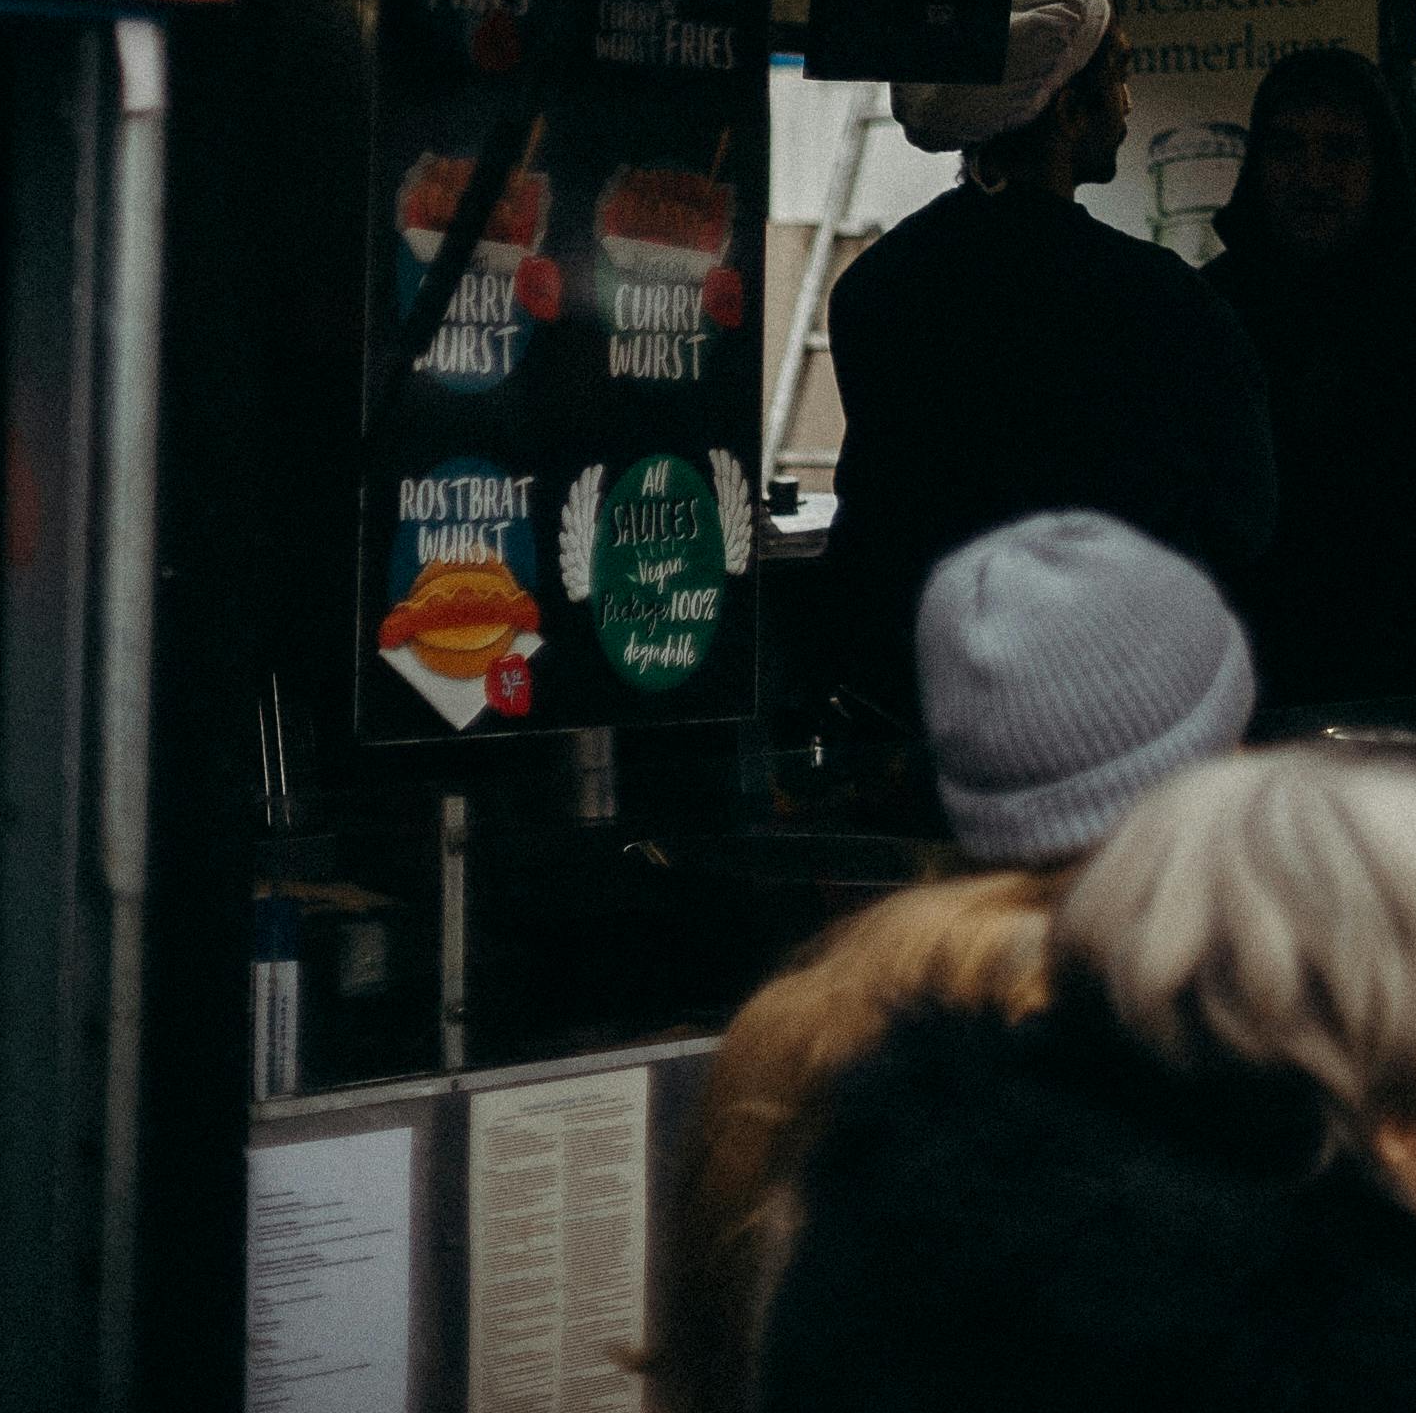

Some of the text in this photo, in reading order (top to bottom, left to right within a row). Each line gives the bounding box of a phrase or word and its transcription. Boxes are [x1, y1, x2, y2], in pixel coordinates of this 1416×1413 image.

[664, 20, 736, 71] FRIES
[438, 273, 517, 323] RRY
[613, 283, 704, 332] CURRY
[608, 334, 708, 381] WURST
[399, 476, 534, 521] ROSTBRAT
[642, 459, 671, 498] All
[417, 522, 511, 565] WURST
[611, 497, 699, 547] SAUCES
[670, 586, 719, 623] 100%
